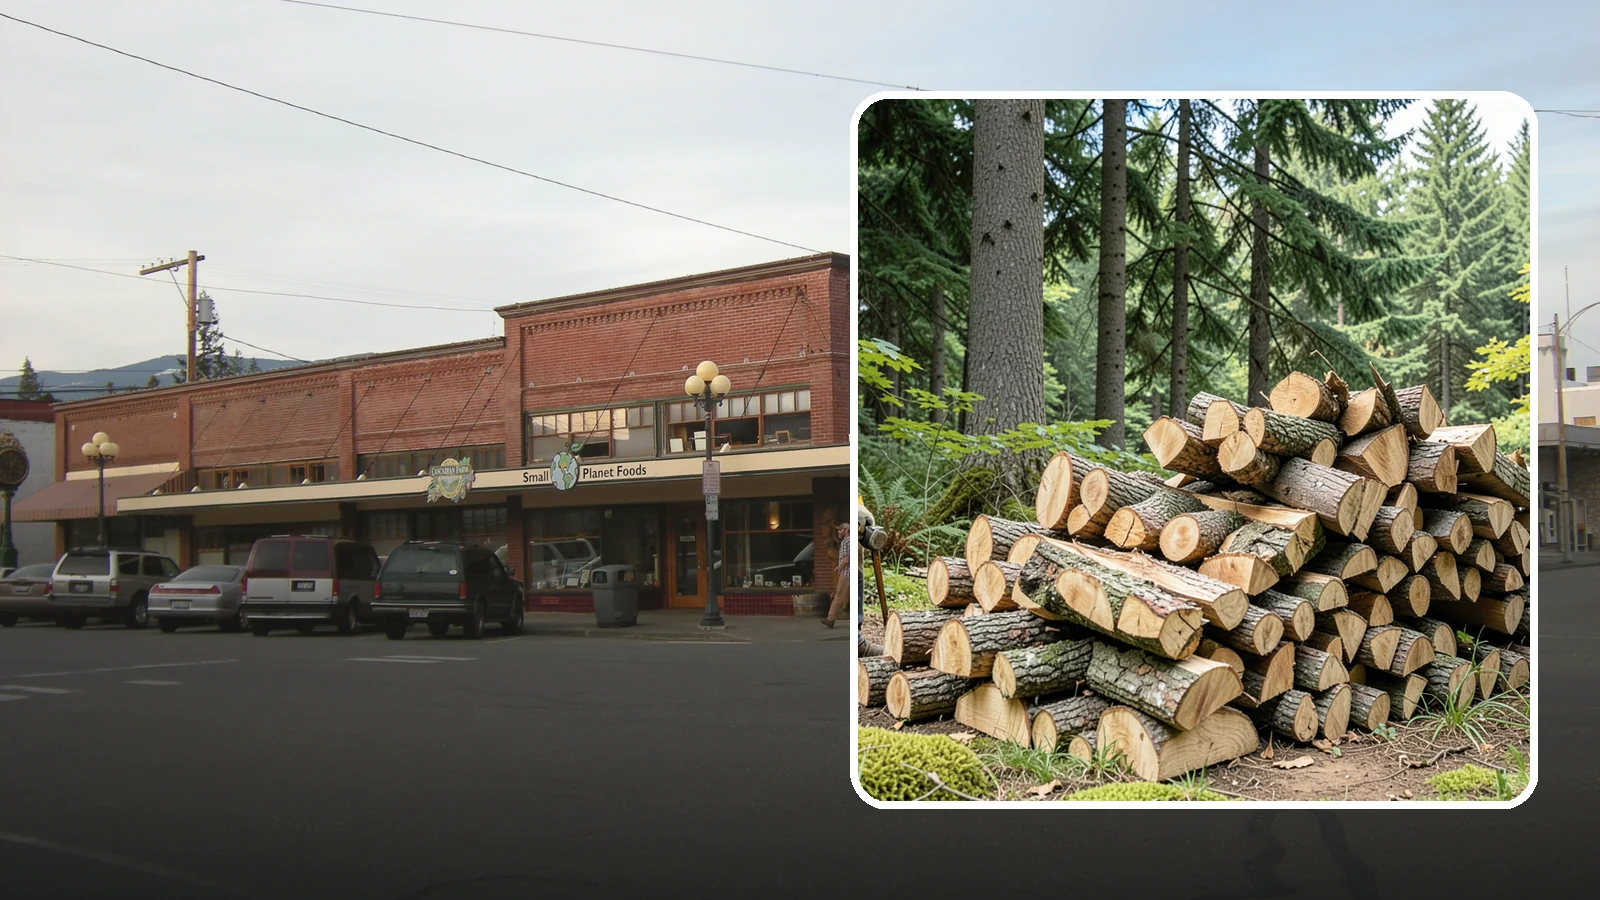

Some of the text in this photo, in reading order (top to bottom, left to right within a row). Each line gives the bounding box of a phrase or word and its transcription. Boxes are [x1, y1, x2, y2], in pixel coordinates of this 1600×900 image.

[523, 464, 647, 483] Small Planet Foods
